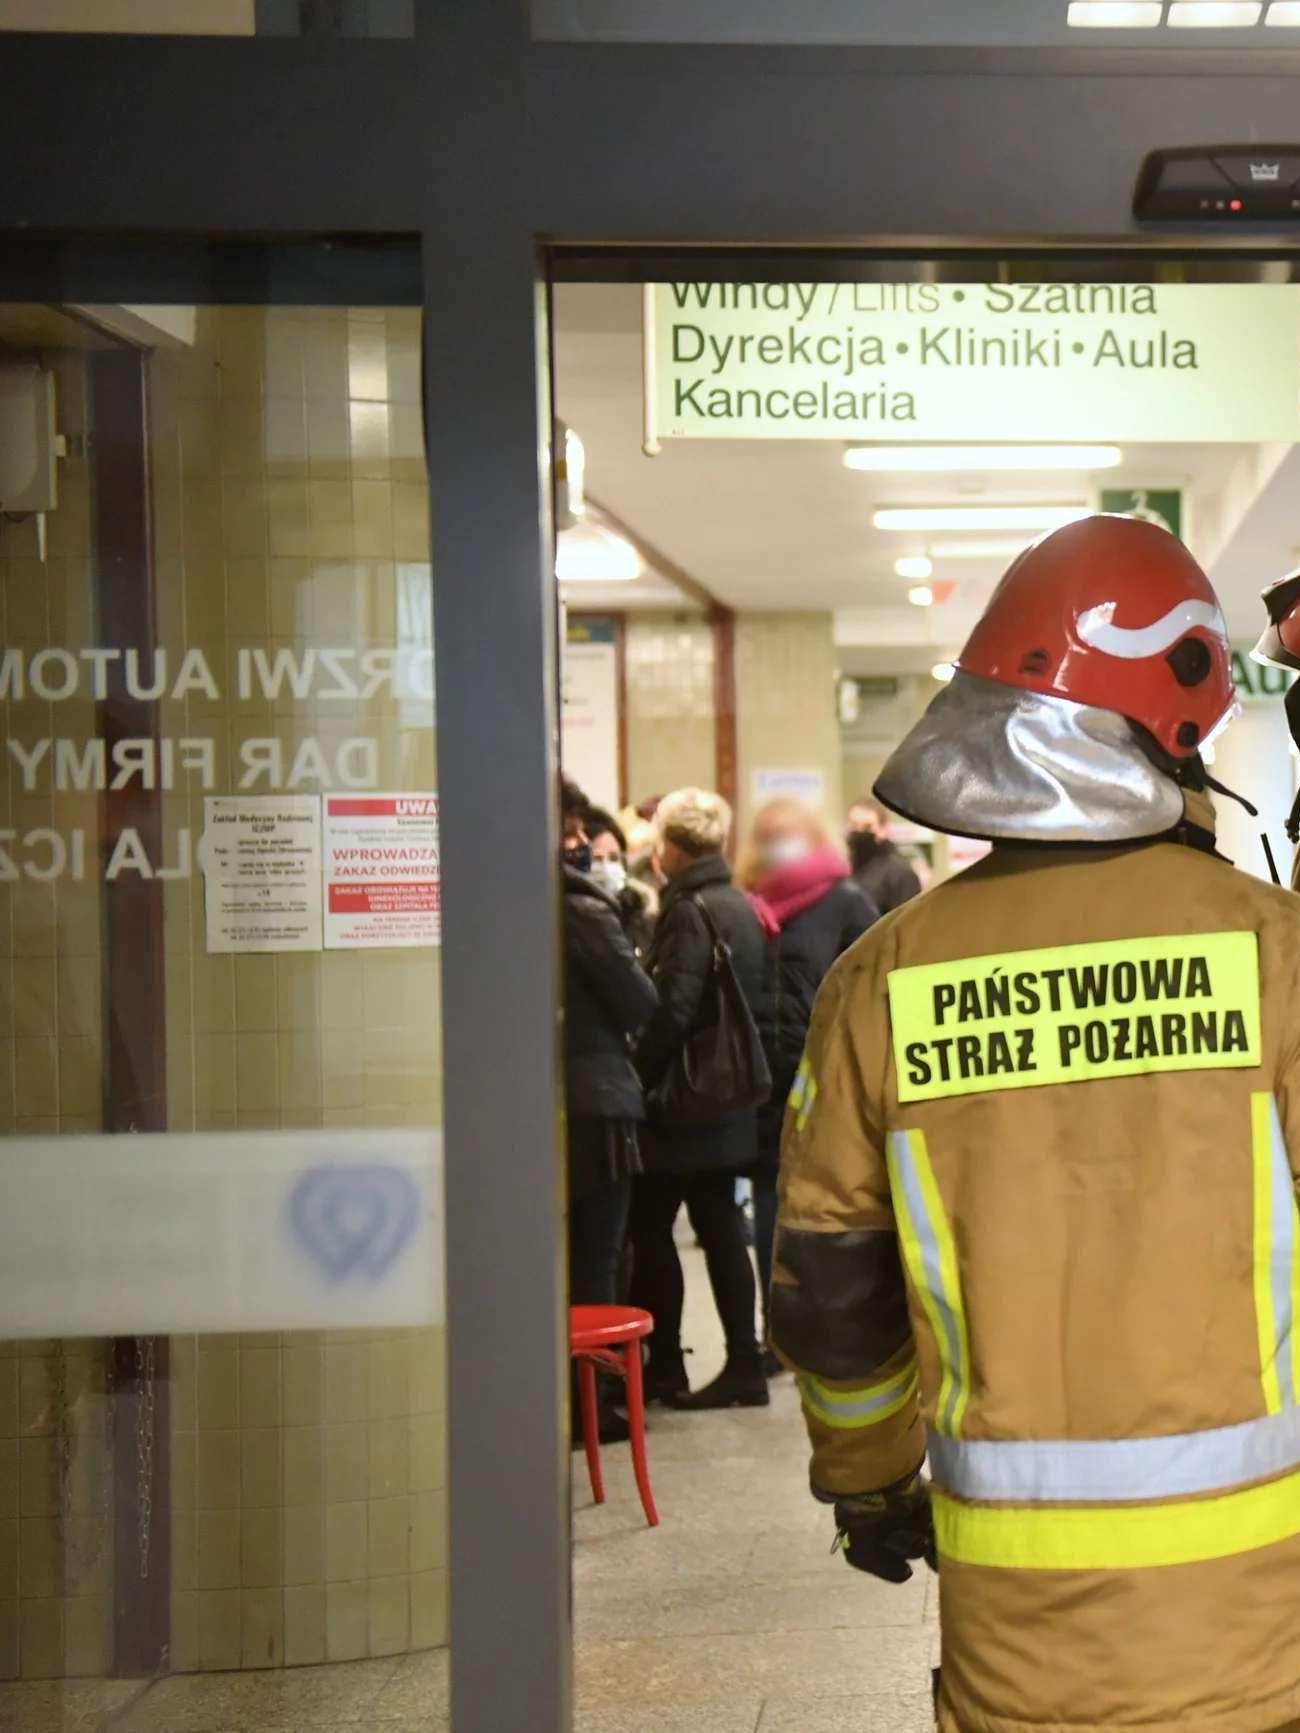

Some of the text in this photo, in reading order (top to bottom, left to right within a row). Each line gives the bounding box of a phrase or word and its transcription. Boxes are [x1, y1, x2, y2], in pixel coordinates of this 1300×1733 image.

[984, 283, 1158, 314] Szatnia
[672, 324, 1199, 376] Dyrekcja Kliniki Aula
[674, 378, 917, 421] Kancelaria
[395, 800, 439, 815] UWA
[932, 956, 1213, 1026] PAŃSTWOWA
[905, 1010, 1249, 1086] STRAŻ POŻARNA
